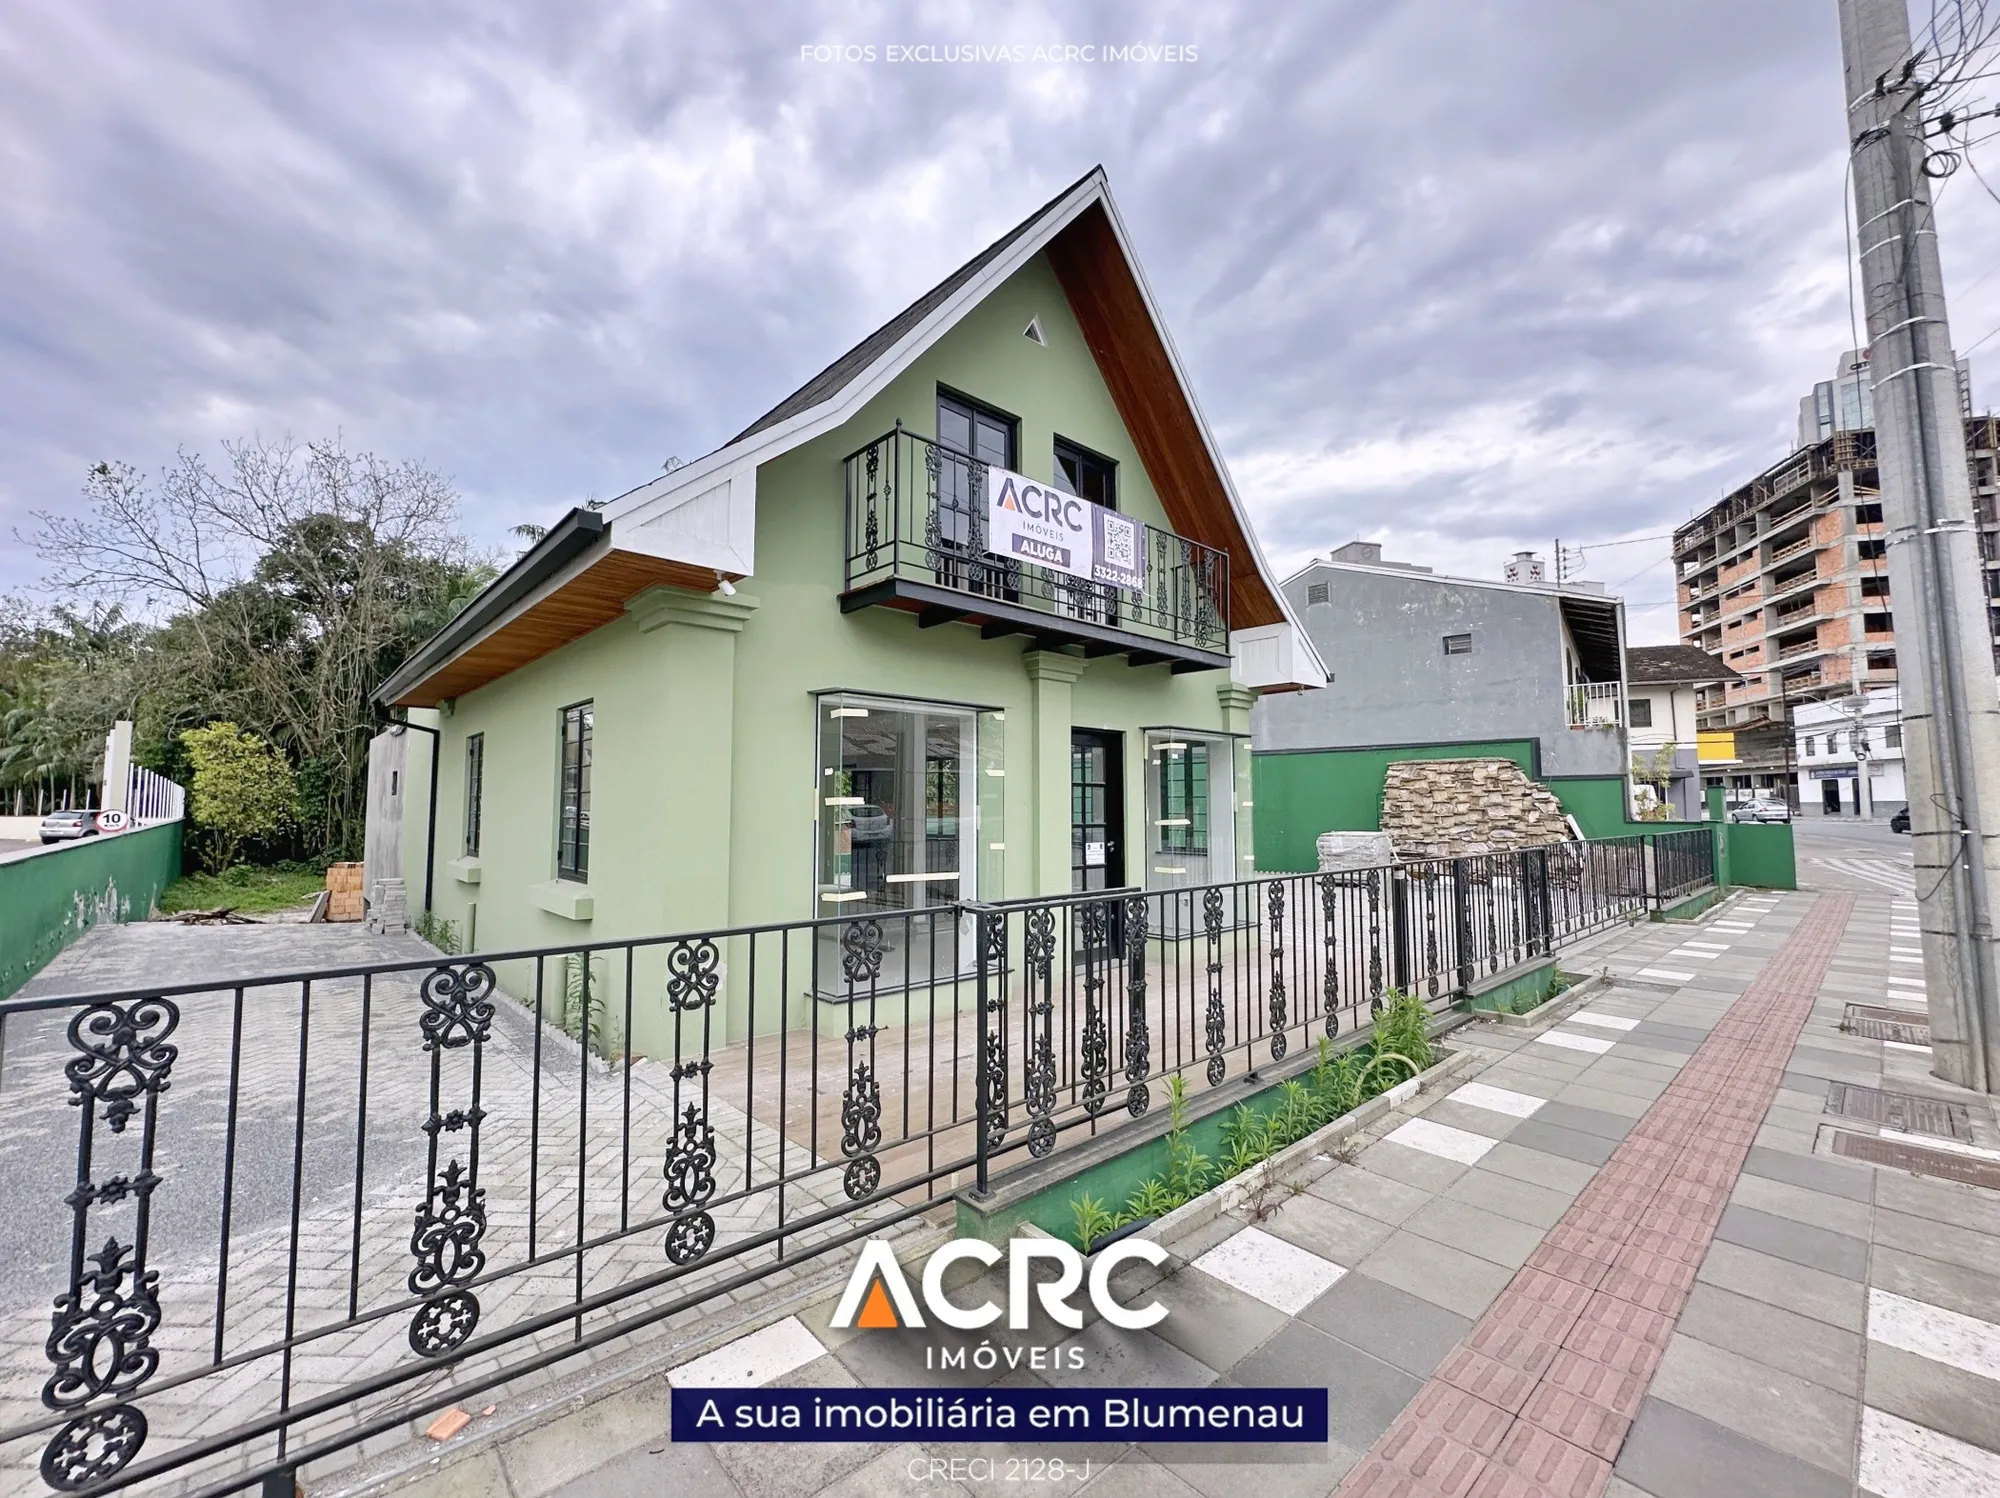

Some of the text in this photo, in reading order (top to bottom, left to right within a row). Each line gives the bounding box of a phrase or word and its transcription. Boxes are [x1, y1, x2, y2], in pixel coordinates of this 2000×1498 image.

[996, 477, 1083, 532] ACRC
[1022, 520, 1064, 542] IMÓVEIS
[1020, 542, 1064, 564] ALUGA
[1094, 564, 1143, 589] 3322-2868
[103, 813, 121, 824] 10
